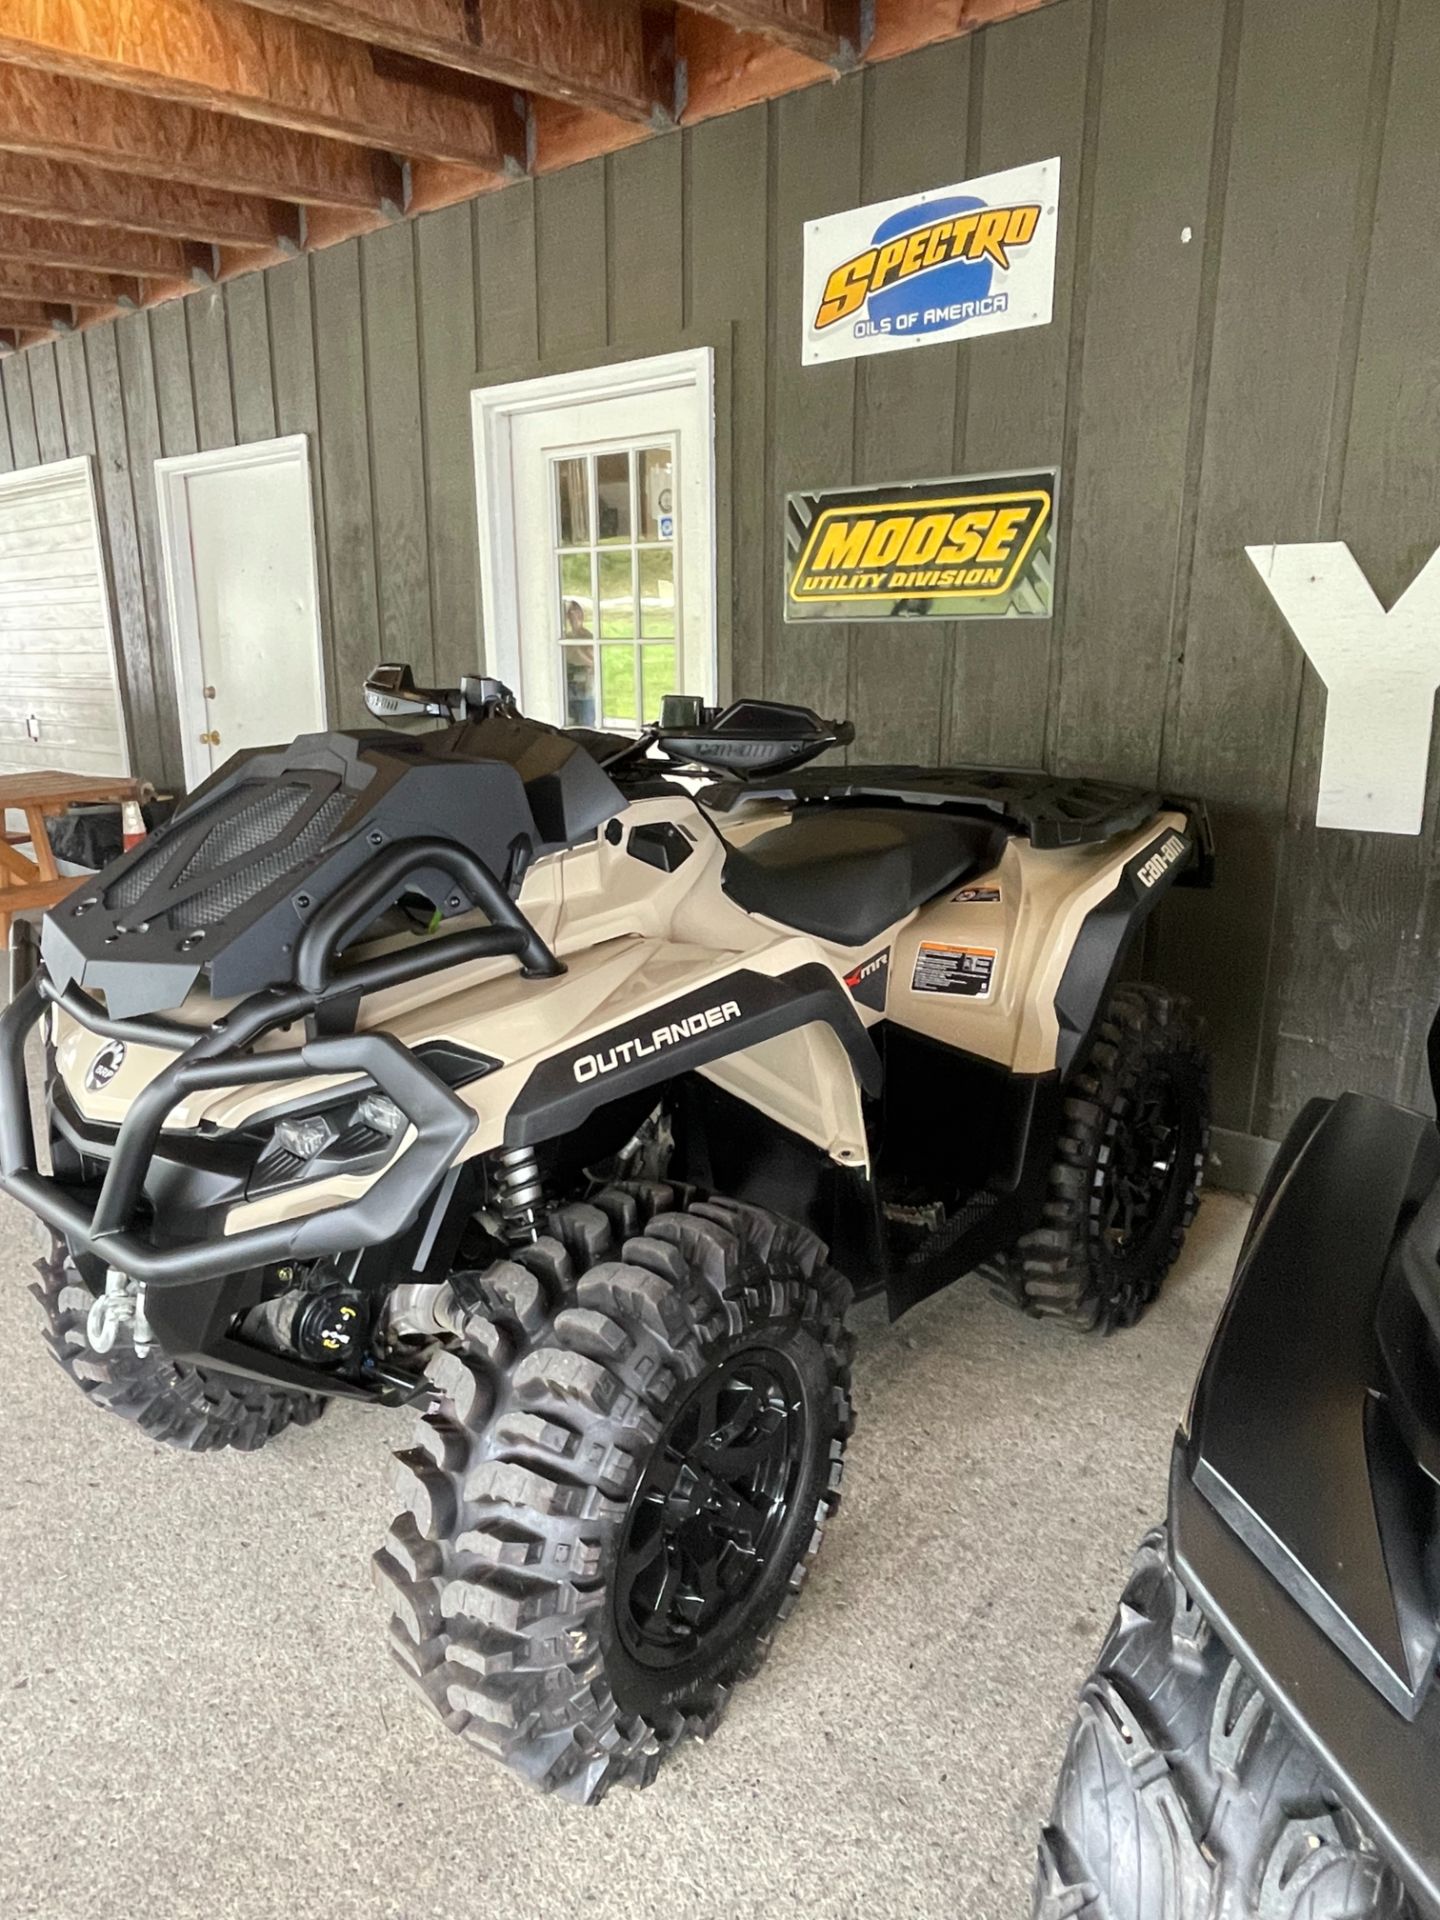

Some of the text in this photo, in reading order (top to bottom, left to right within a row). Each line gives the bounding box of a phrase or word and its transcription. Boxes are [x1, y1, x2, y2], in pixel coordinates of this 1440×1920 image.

[814, 204, 1042, 329] SPECTRO
[854, 294, 1007, 338] OILS OF AMERICA
[811, 507, 1031, 571] MOOSE
[803, 568, 1003, 591] UTILITY DIVISION
[573, 1000, 742, 1083] OUTLANDER
